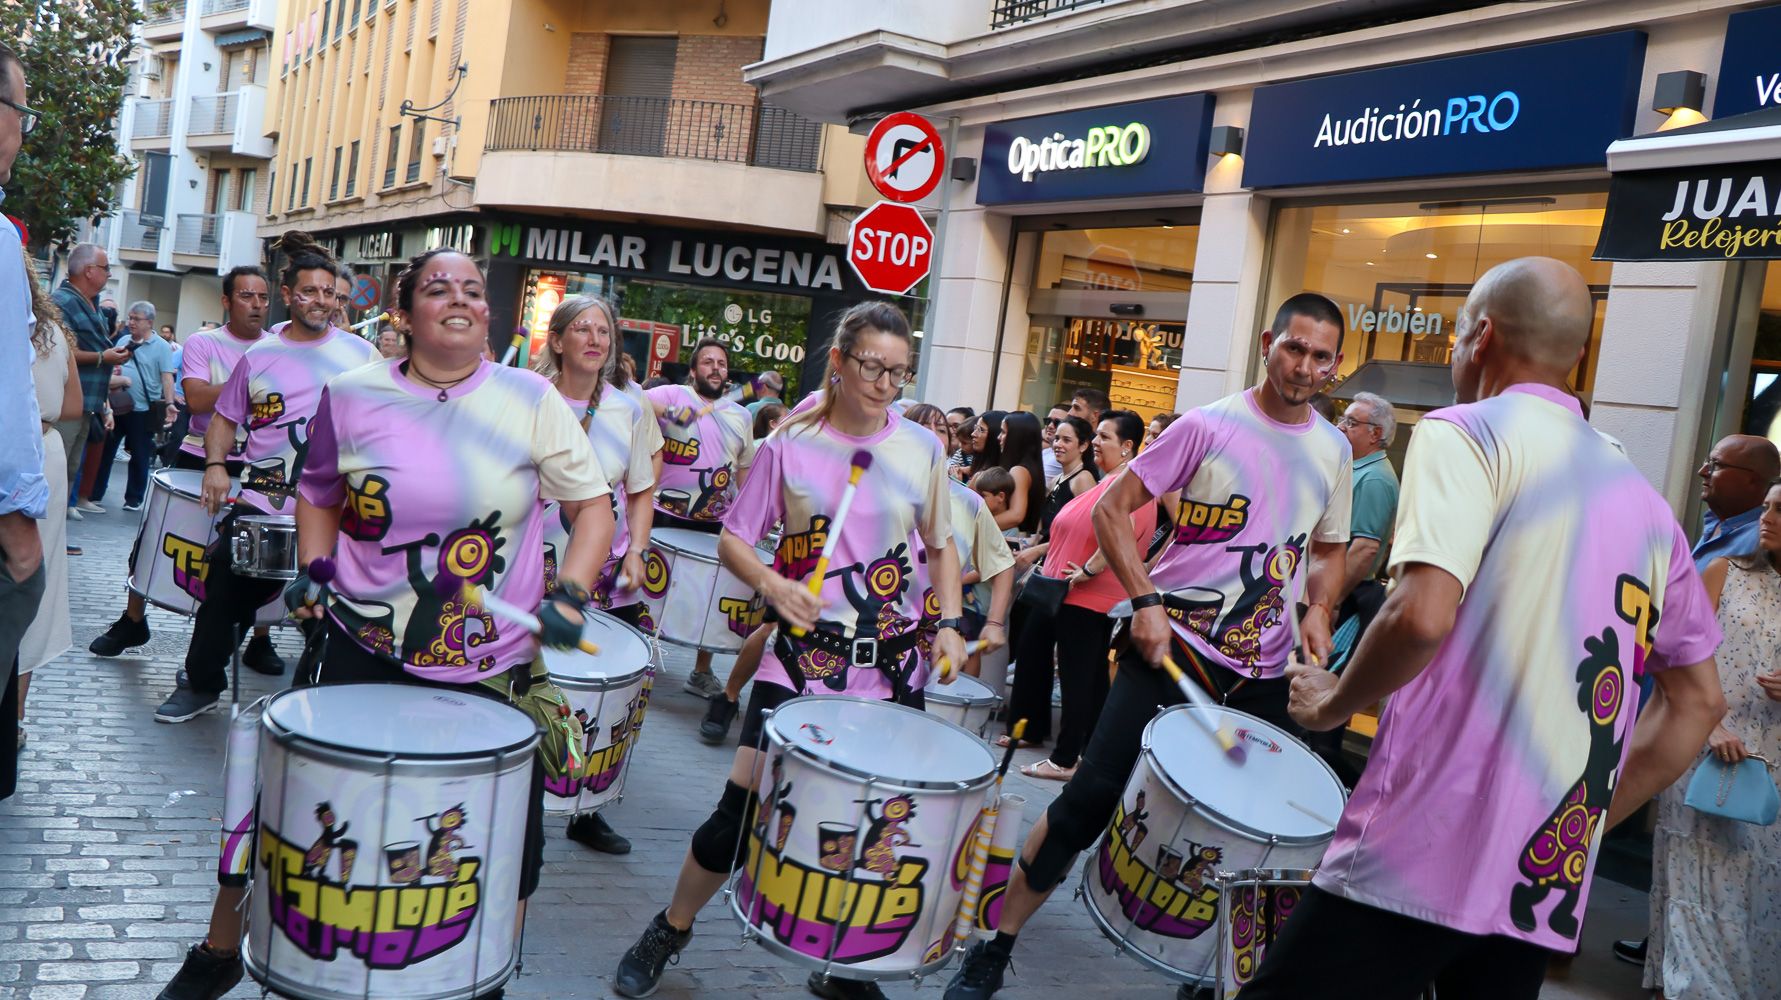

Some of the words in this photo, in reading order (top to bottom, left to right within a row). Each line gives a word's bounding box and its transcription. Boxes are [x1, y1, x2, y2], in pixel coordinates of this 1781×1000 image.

[1313, 90, 1520, 148] AudiciónPRO
[1008, 122, 1151, 183] OpticaPRO
[357, 232, 394, 258] LUCENA
[526, 227, 647, 270] MILAR
[668, 240, 843, 291] LUCENA
[856, 227, 929, 268] STOP
[748, 308, 772, 324] LG
[755, 334, 806, 363] Goo
